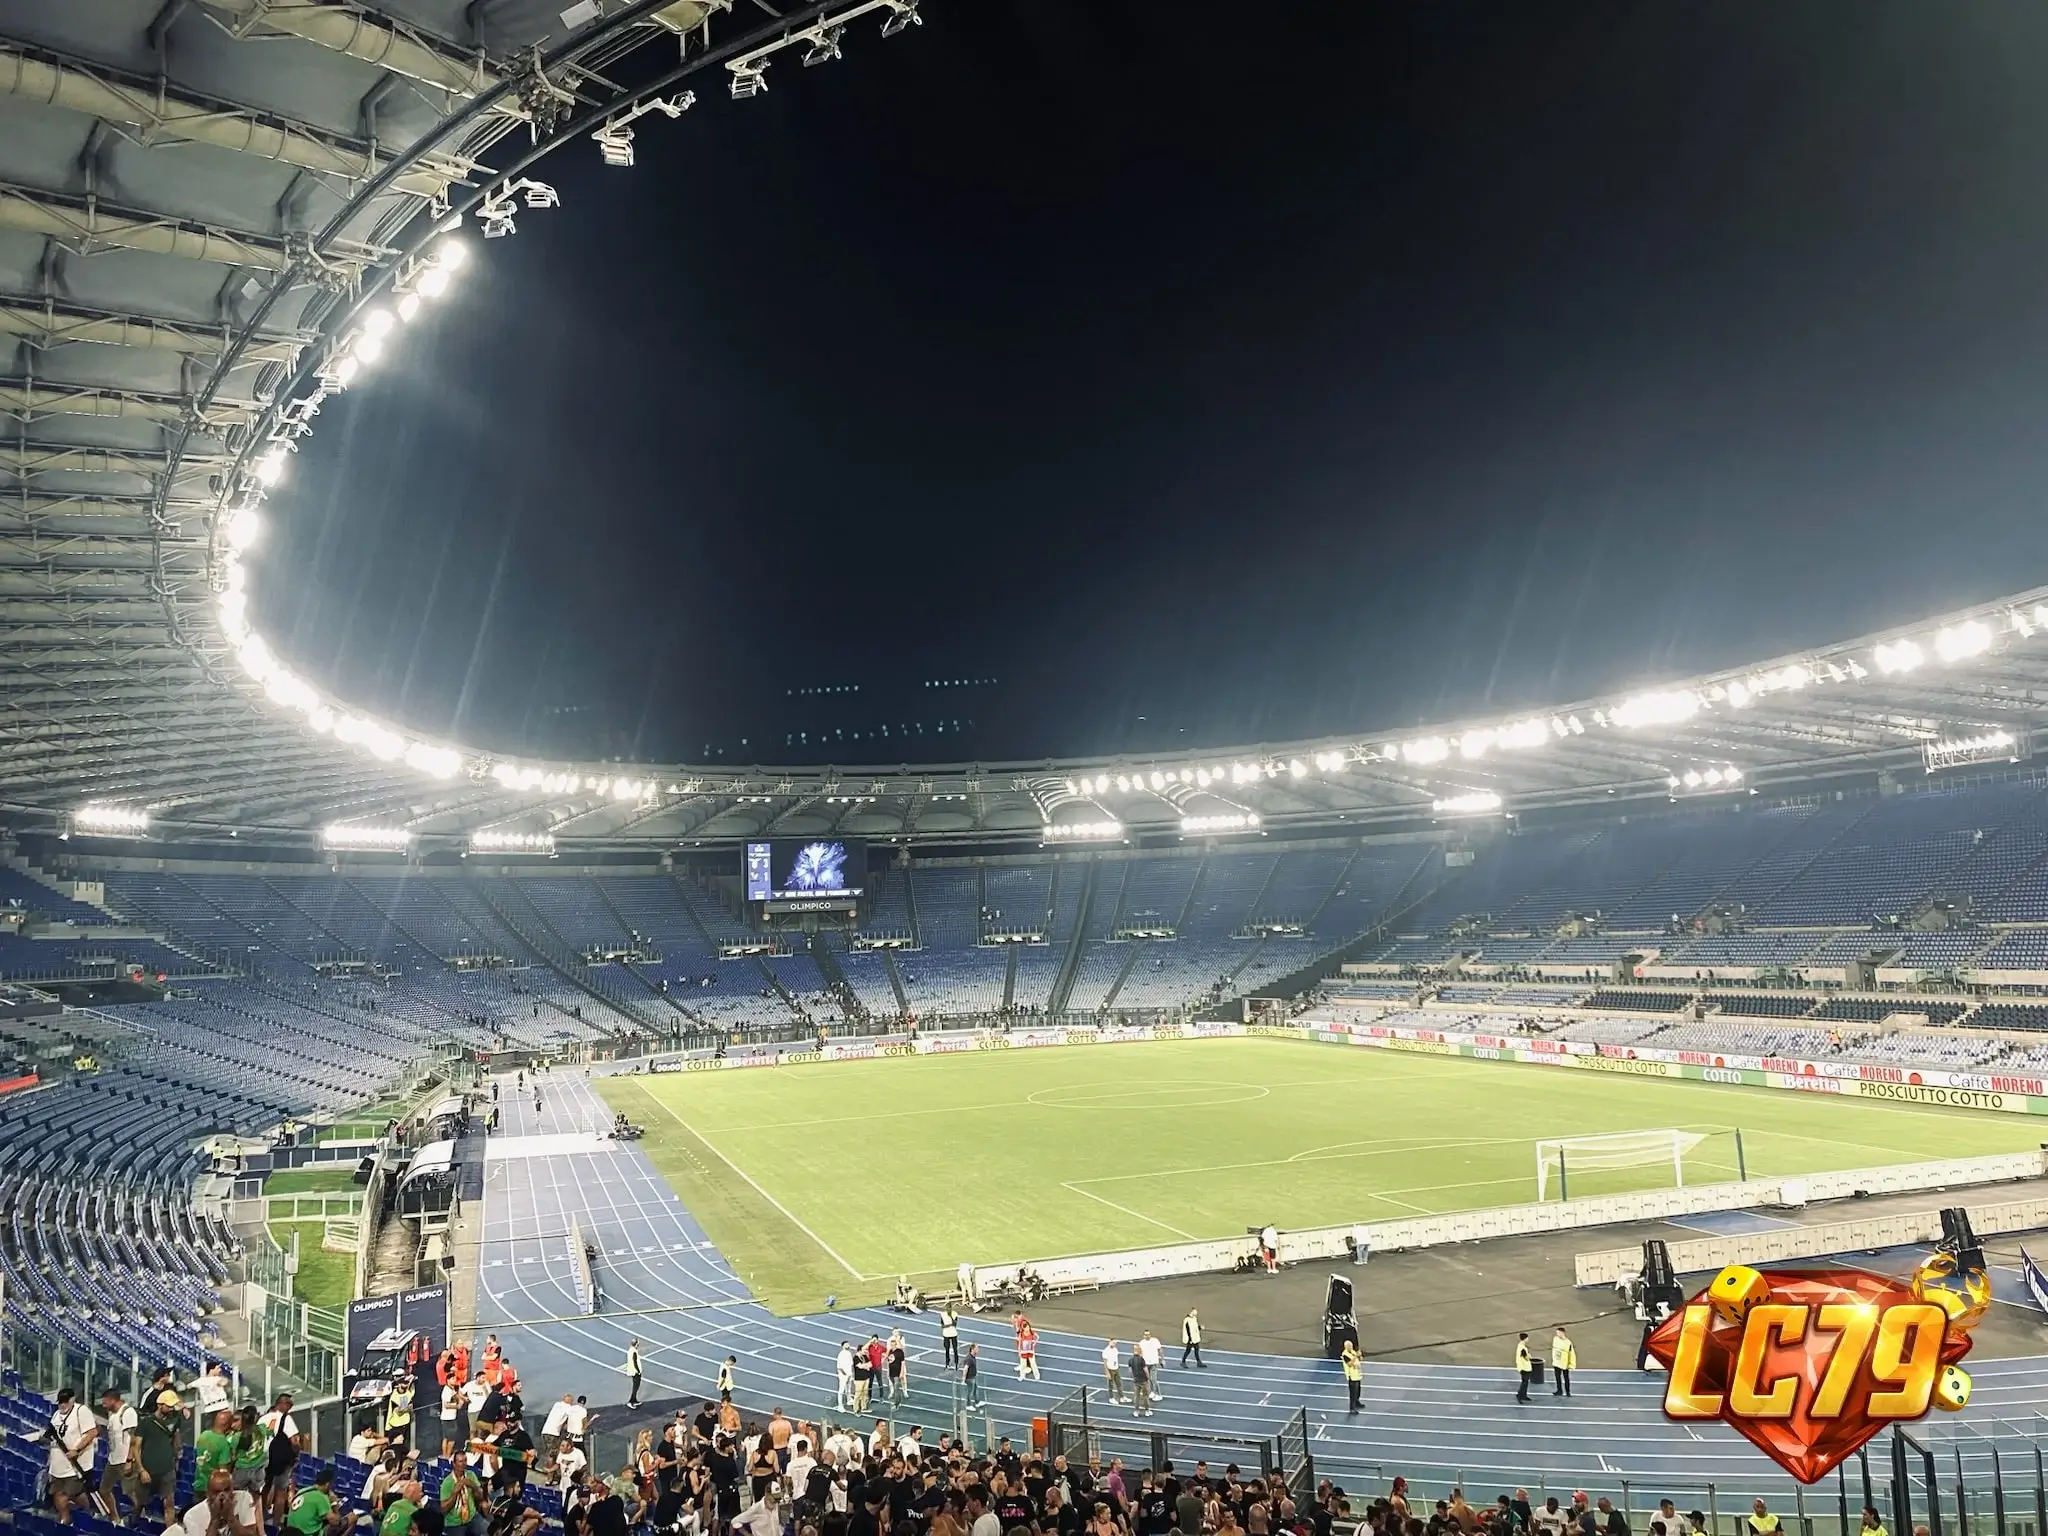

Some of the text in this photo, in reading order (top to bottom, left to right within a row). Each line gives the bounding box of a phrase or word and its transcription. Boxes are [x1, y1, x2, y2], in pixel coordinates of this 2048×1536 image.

[790, 902, 831, 911] OLIMPICO
[1067, 1034, 1097, 1044] COTTO
[1154, 1030, 1184, 1040] COTTO
[884, 1046, 917, 1056] COTTO
[979, 1040, 1010, 1050] COTTO
[788, 1052, 822, 1063] COTTO
[1473, 1048, 1500, 1060] COTTO
[1678, 1051, 1711, 1065] MORENO
[687, 1060, 722, 1071] COTTO
[1580, 1056, 1667, 1075] PROSCIUTTO COTTO
[1761, 1059, 1799, 1074] MORENO
[1703, 1069, 1741, 1085] COTTO
[1859, 1066, 1902, 1082] MORENO
[1948, 1073, 2044, 1096] Caffè MORENO
[1860, 1082, 2003, 1109] PROSCIUTTO COTTO
[405, 1289, 443, 1303] OLIMPICO
[353, 1299, 393, 1313] OLIMPICO
